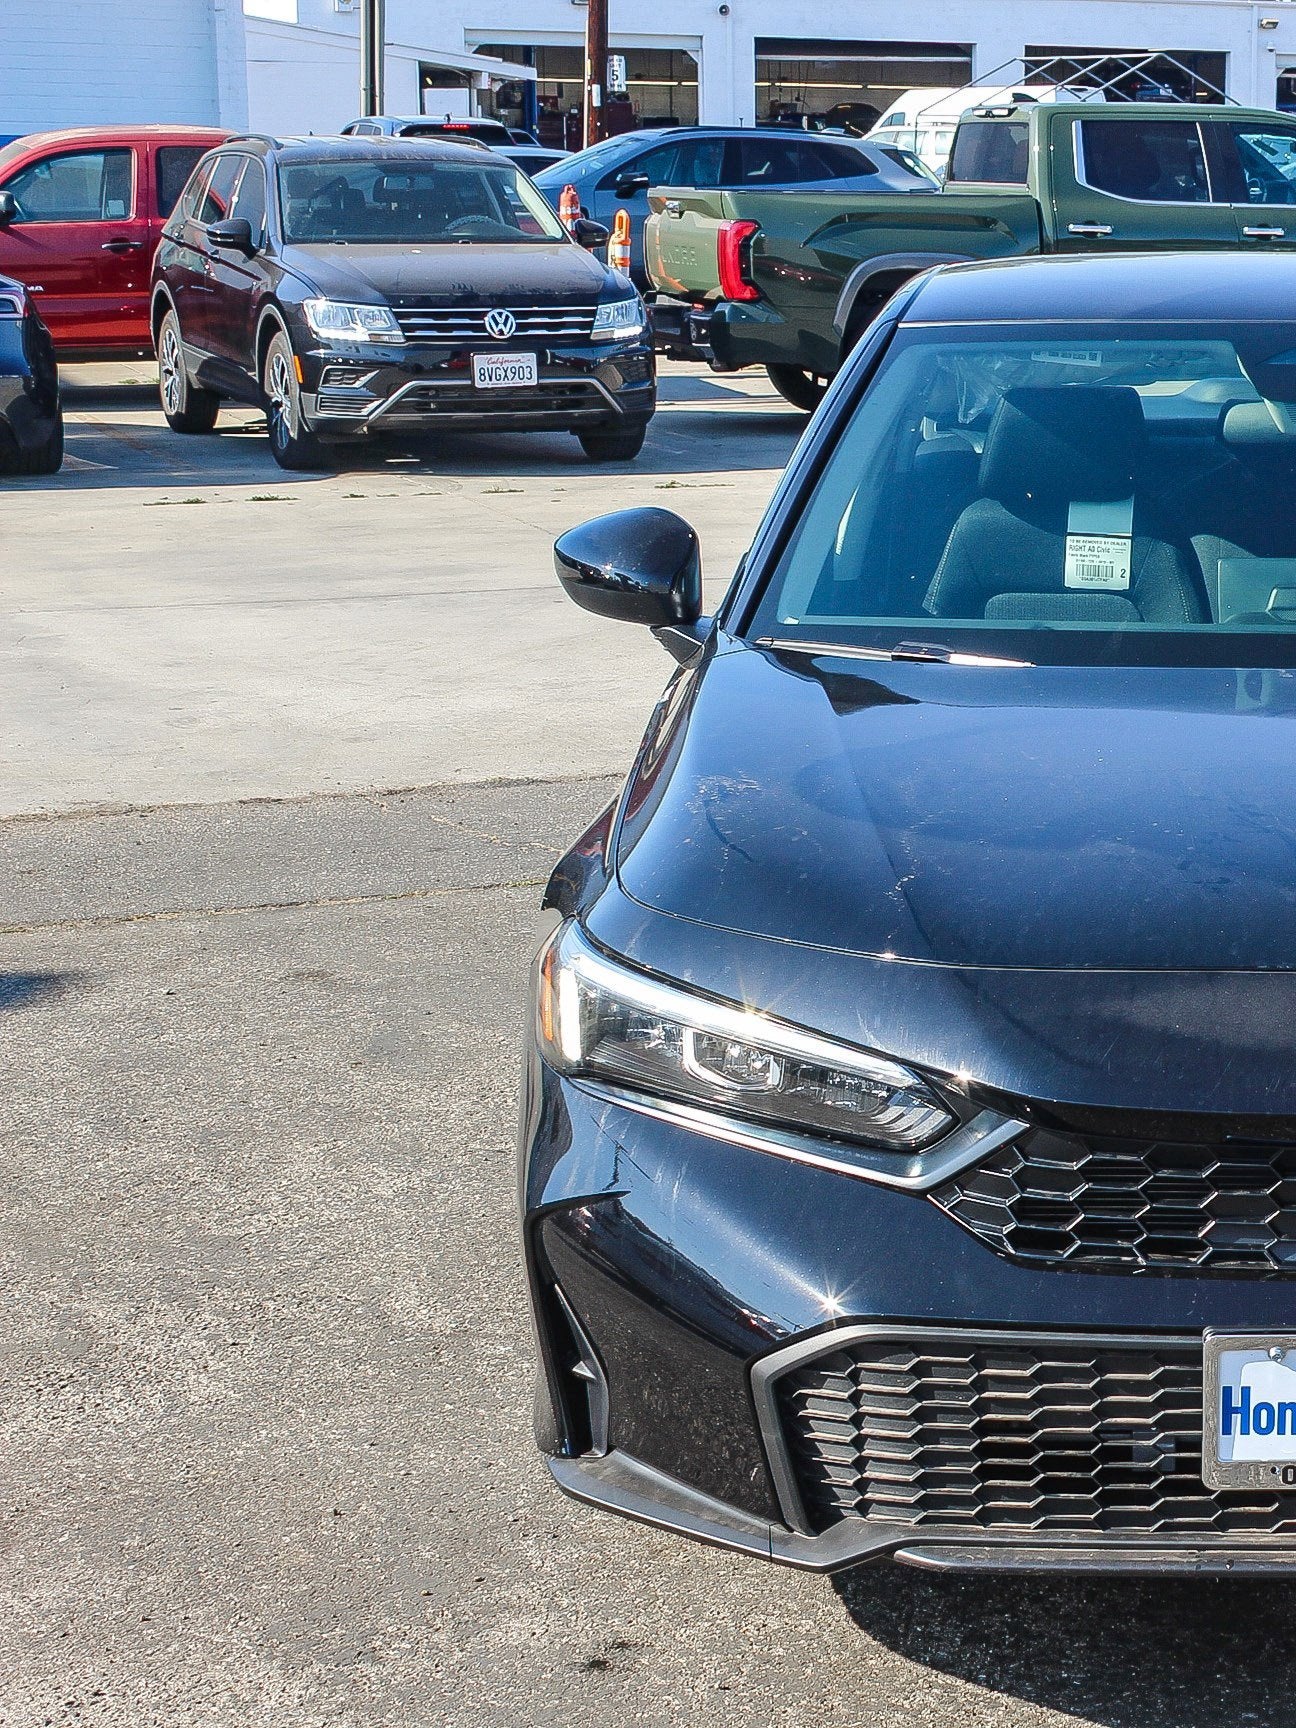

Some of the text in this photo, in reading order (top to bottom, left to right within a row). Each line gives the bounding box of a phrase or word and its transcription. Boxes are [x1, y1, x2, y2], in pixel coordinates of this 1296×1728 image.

[611, 69, 619, 81] 5
[478, 366, 533, 382] 8VGX903
[1069, 544, 1086, 552] RIGHT
[1120, 568, 1127, 579] 2
